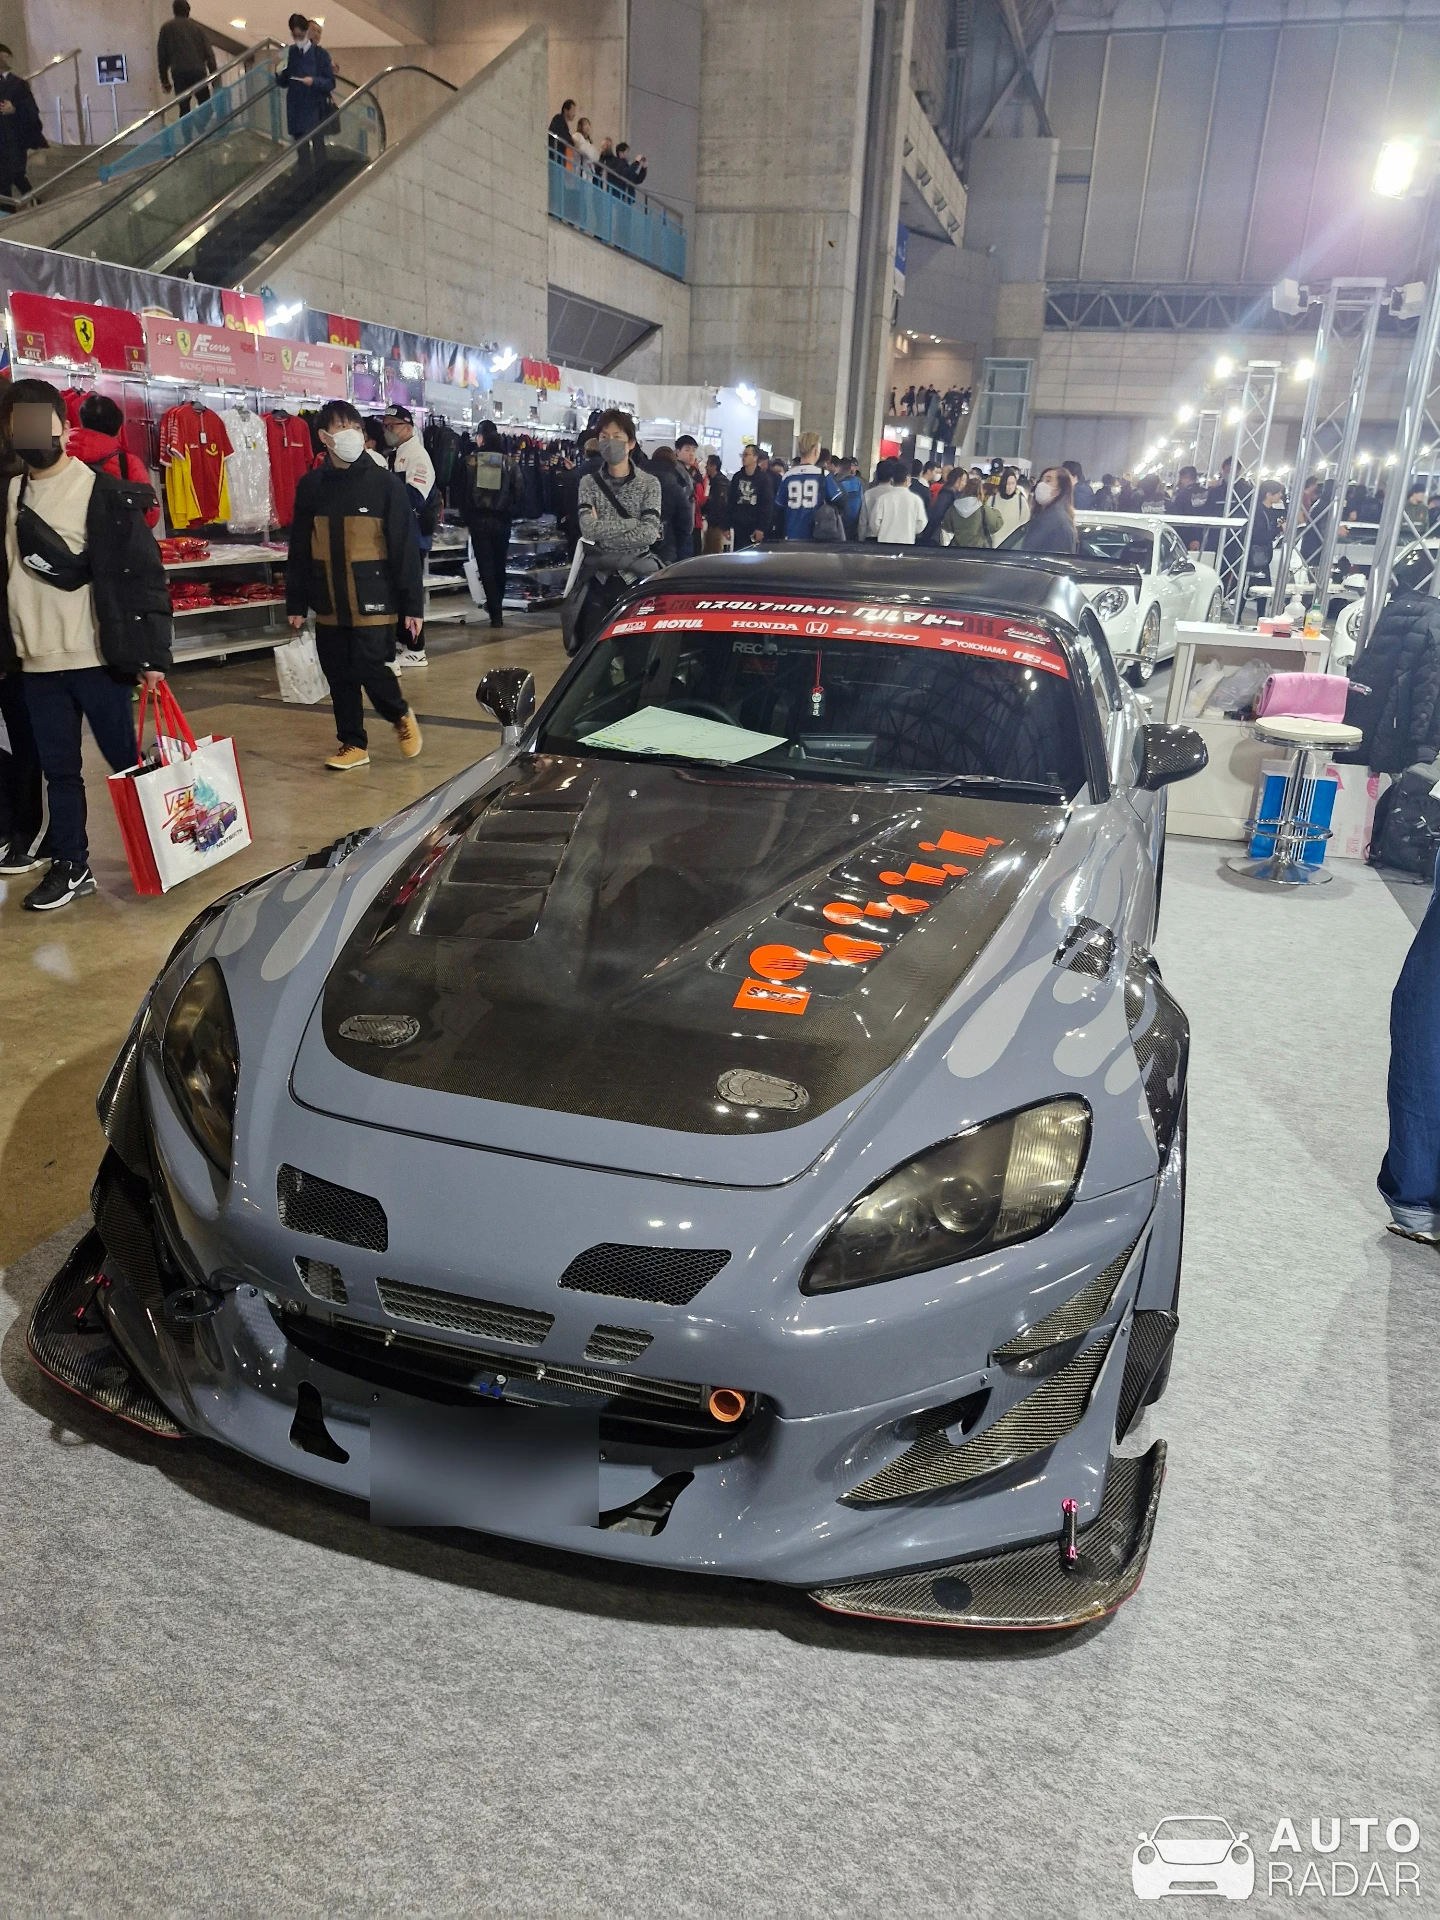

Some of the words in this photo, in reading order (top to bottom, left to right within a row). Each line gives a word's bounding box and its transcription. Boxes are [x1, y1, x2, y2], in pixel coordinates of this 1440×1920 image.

[788, 479, 818, 509] 99
[652, 619, 703, 630] MOTUL
[731, 620, 799, 631] HONDA
[956, 641, 1008, 656] YOKOHAMA
